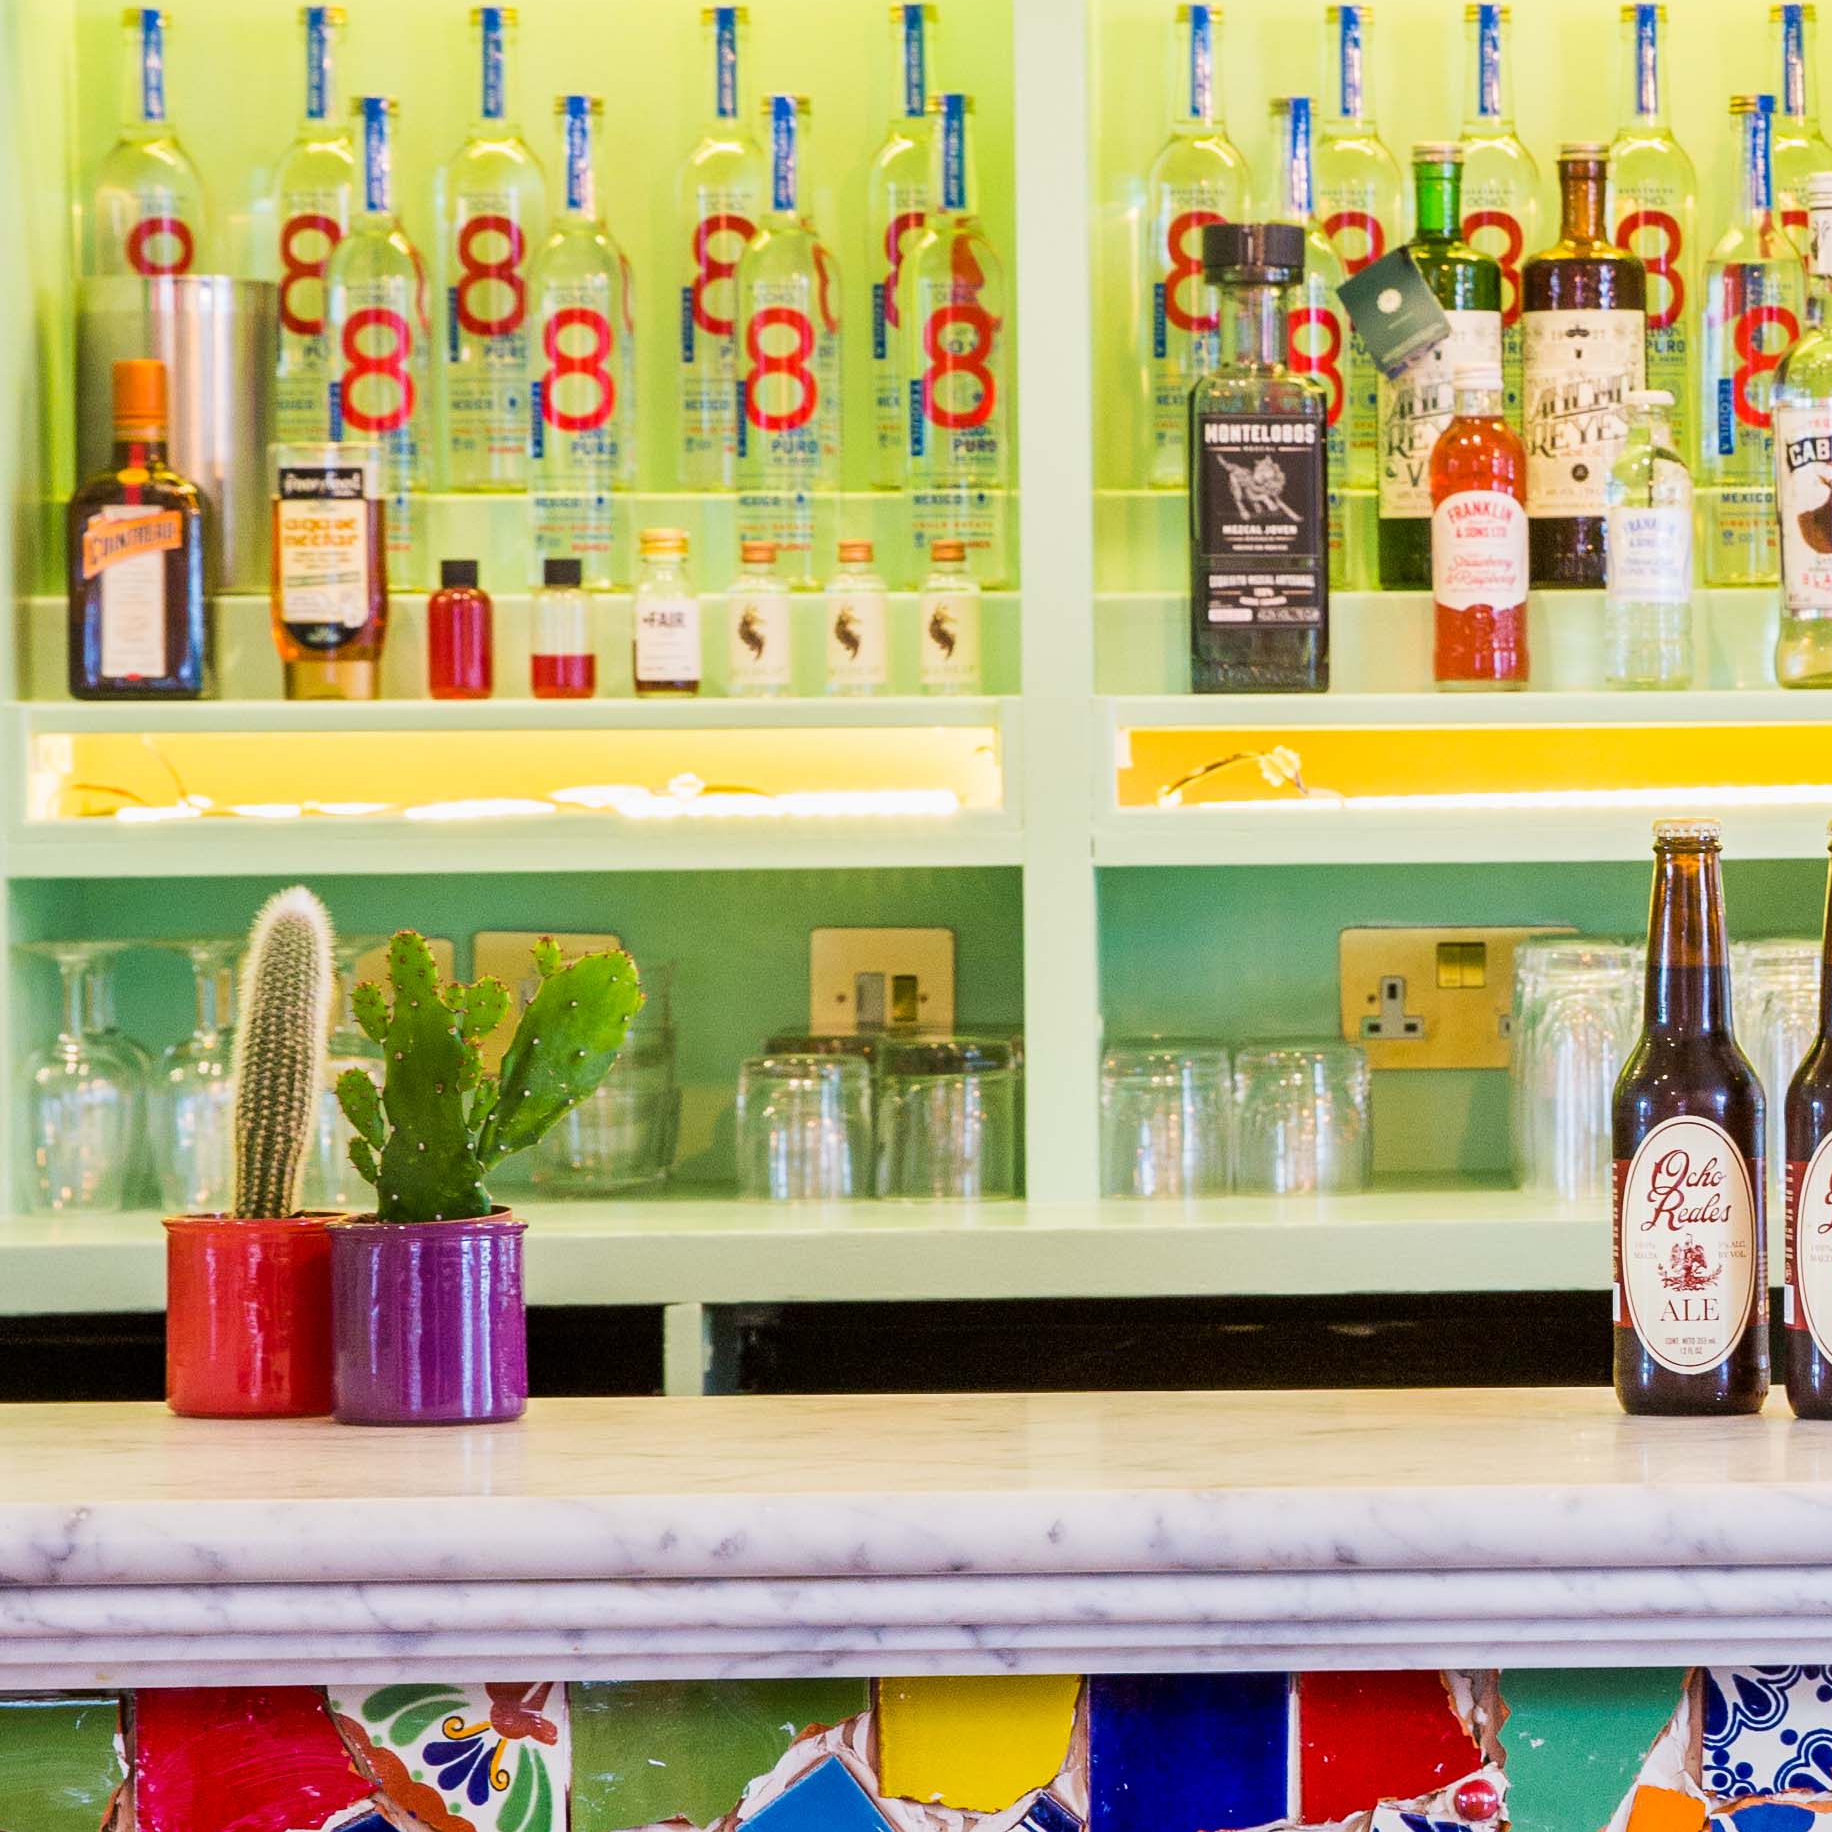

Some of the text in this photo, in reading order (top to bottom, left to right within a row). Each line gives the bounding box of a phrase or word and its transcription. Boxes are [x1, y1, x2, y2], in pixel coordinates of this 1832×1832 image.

[456, 215, 526, 336] 8
[341, 308, 414, 432] 8
[542, 308, 615, 432] 8
[745, 307, 817, 431] 8
[923, 305, 996, 429] 8
[1733, 306, 1800, 429] 8
[1205, 423, 1316, 444] MONTELOBOS
[1448, 501, 1512, 523] FRANKLIN
[1641, 1187, 1732, 1232] Reales
[1651, 1149, 1727, 1190] Ocho
[1660, 1298, 1720, 1322] ALE
